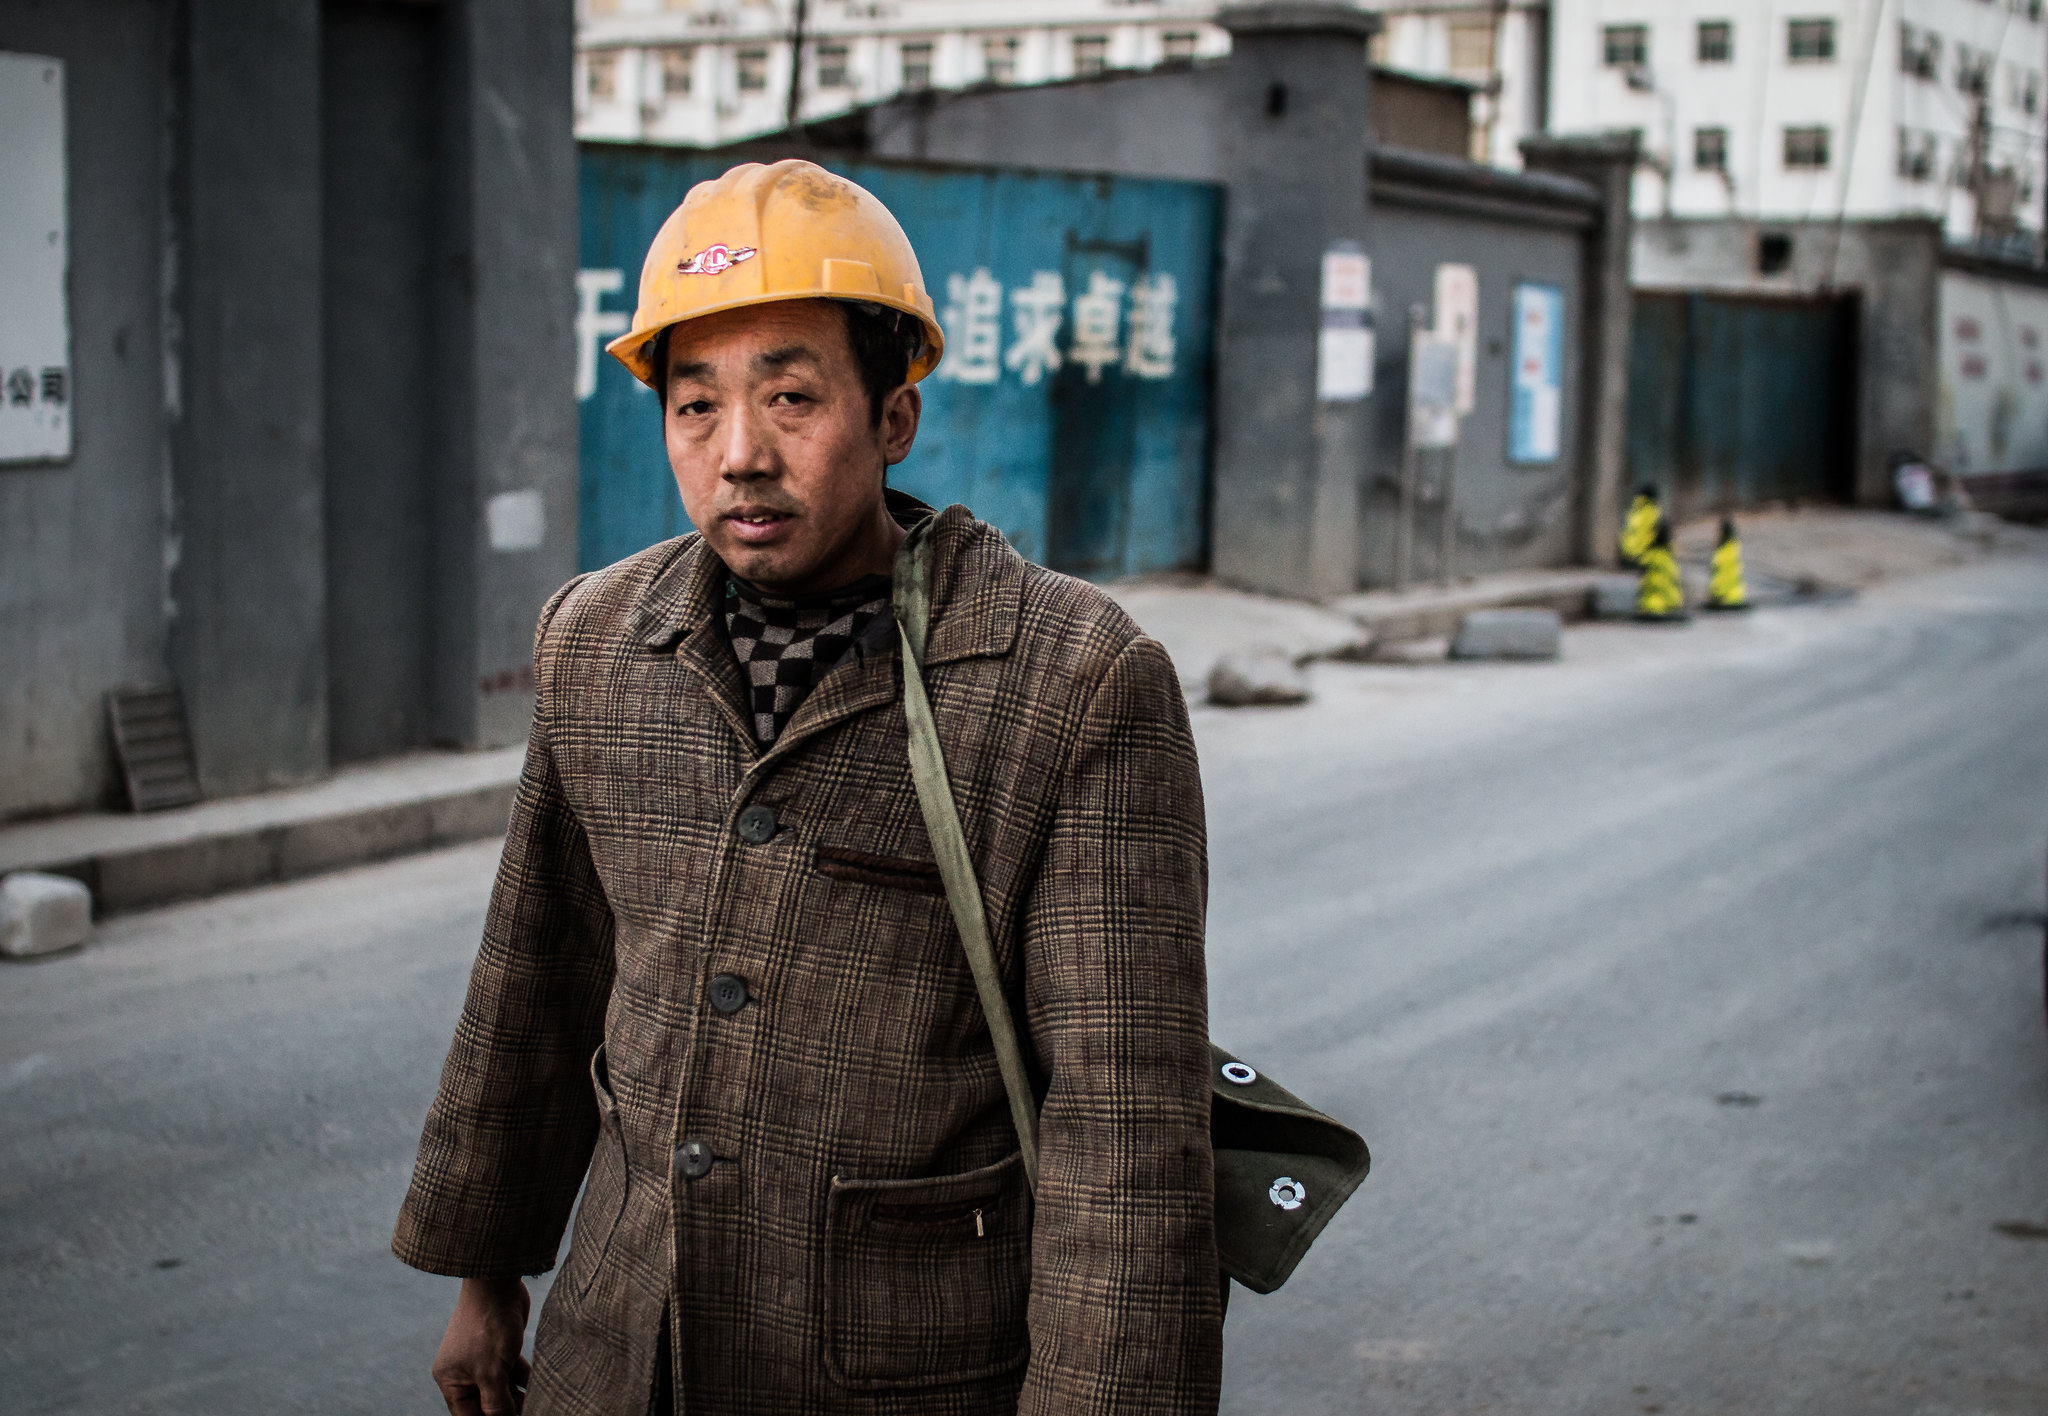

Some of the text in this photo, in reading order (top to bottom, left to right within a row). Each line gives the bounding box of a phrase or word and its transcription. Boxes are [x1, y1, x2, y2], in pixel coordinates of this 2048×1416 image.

[937, 268, 1176, 386] 追求卓越
[0, 367, 68, 407] 公司
